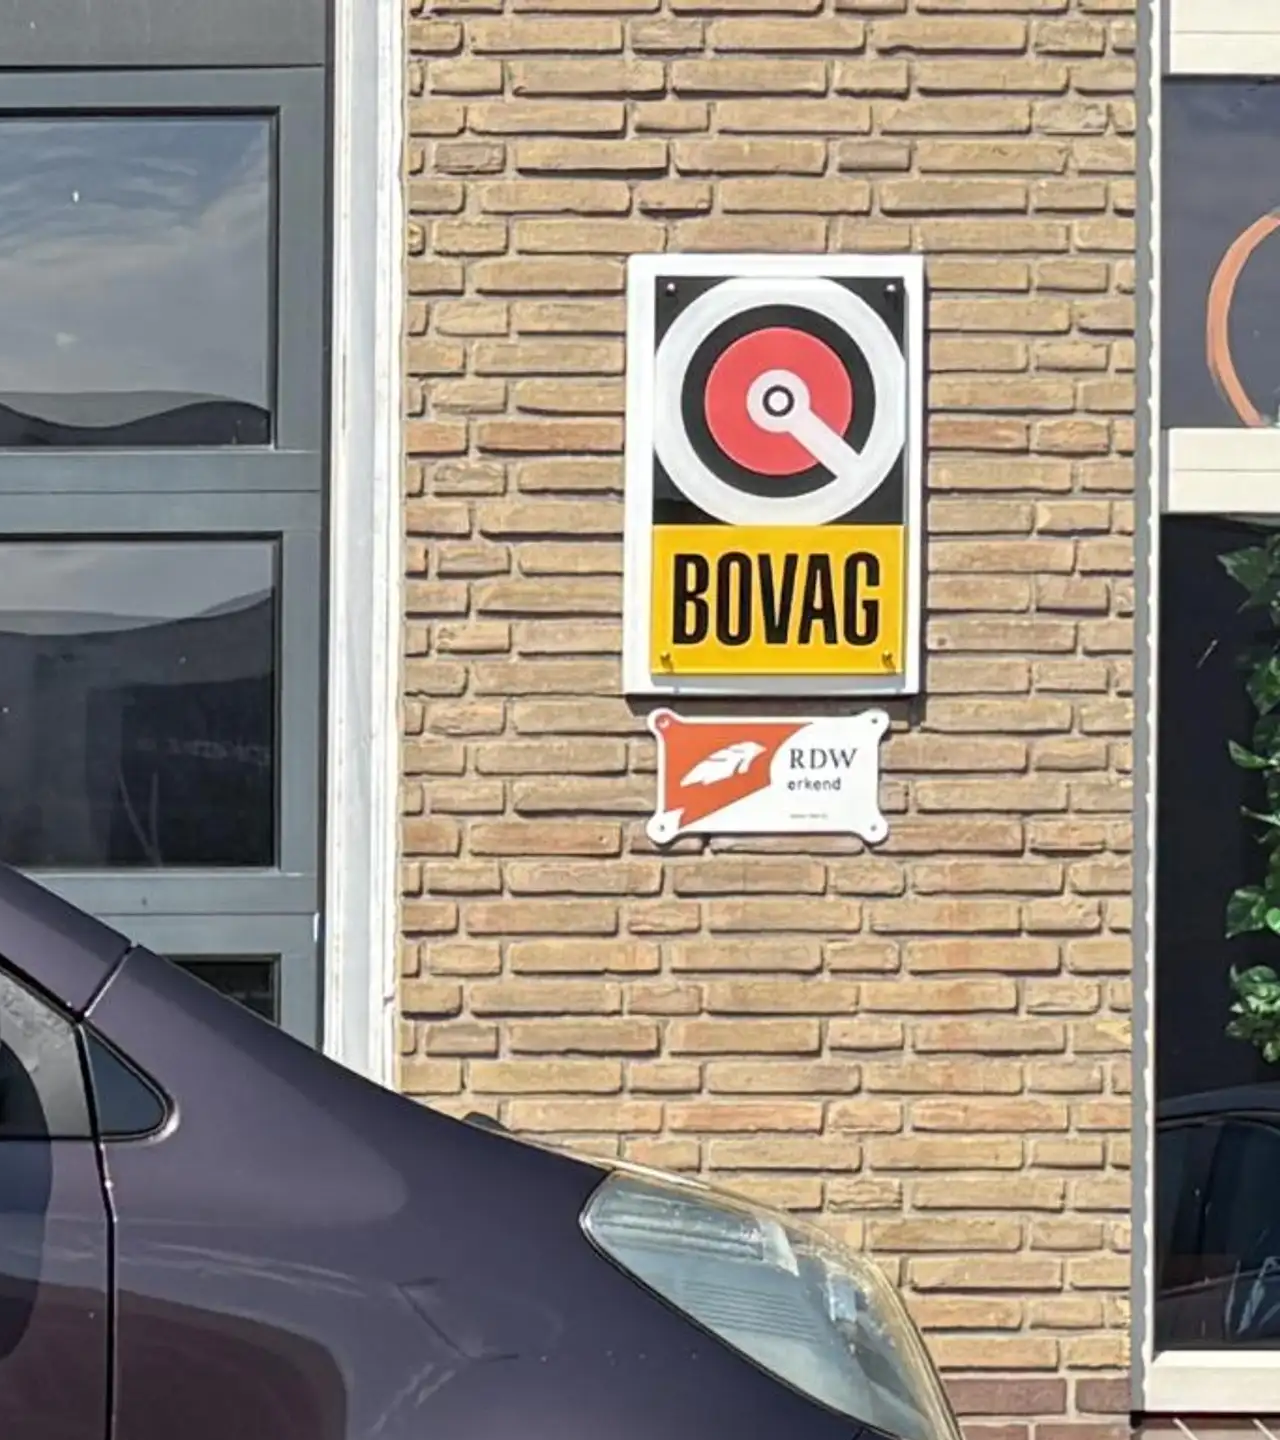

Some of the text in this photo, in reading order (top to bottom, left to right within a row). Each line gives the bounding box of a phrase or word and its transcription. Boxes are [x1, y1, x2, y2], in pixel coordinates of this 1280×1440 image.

[672, 551, 880, 646] BOVAG
[789, 747, 858, 770] RDW
[787, 776, 841, 791] erkend
